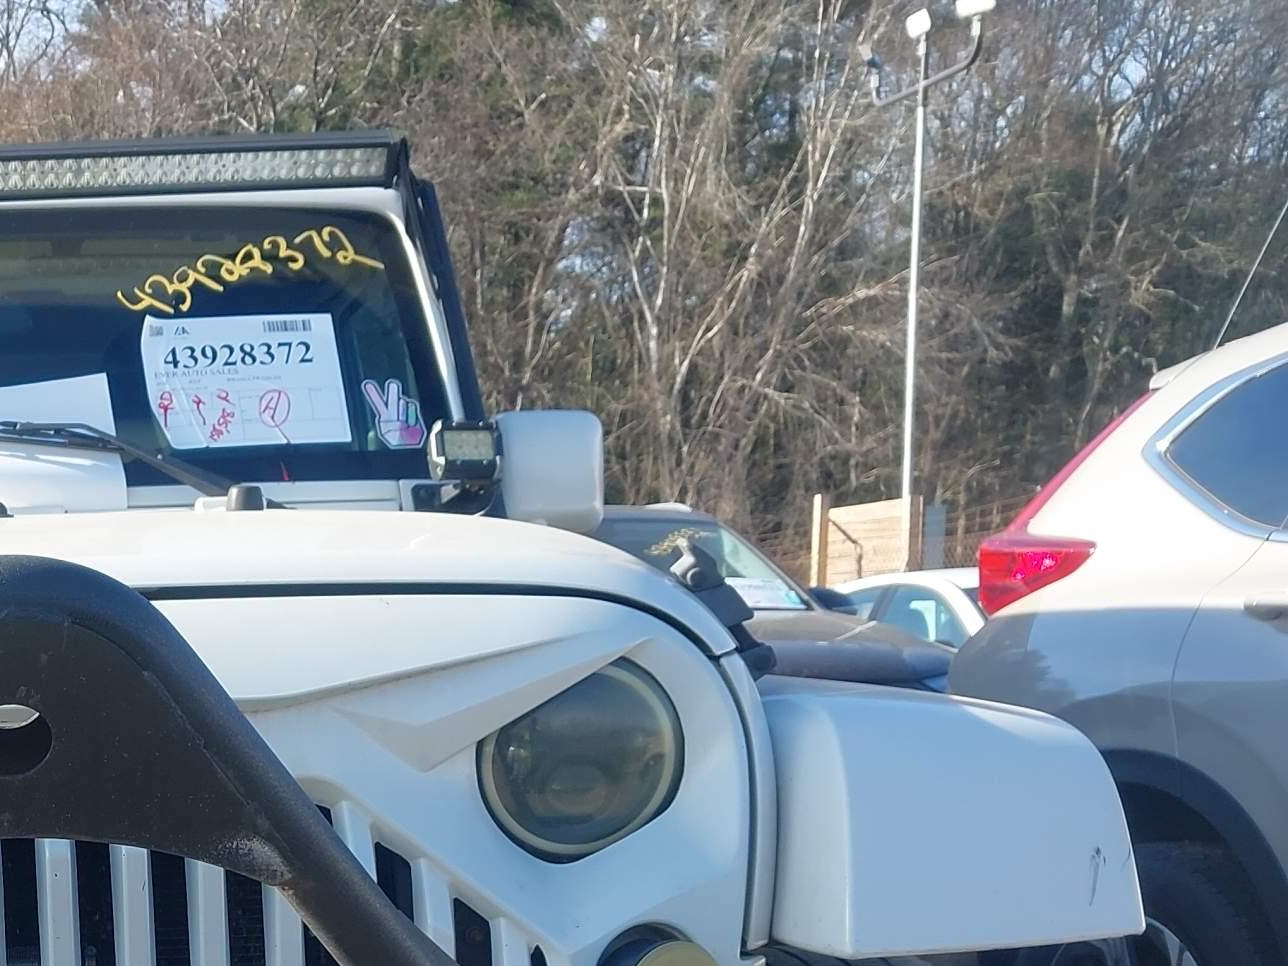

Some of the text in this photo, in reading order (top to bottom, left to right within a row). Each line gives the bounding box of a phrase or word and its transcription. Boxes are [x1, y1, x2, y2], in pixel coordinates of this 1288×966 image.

[163, 341, 314, 369] 43928372
[181, 369, 209, 377] AUTO
[210, 367, 240, 375] SALES
